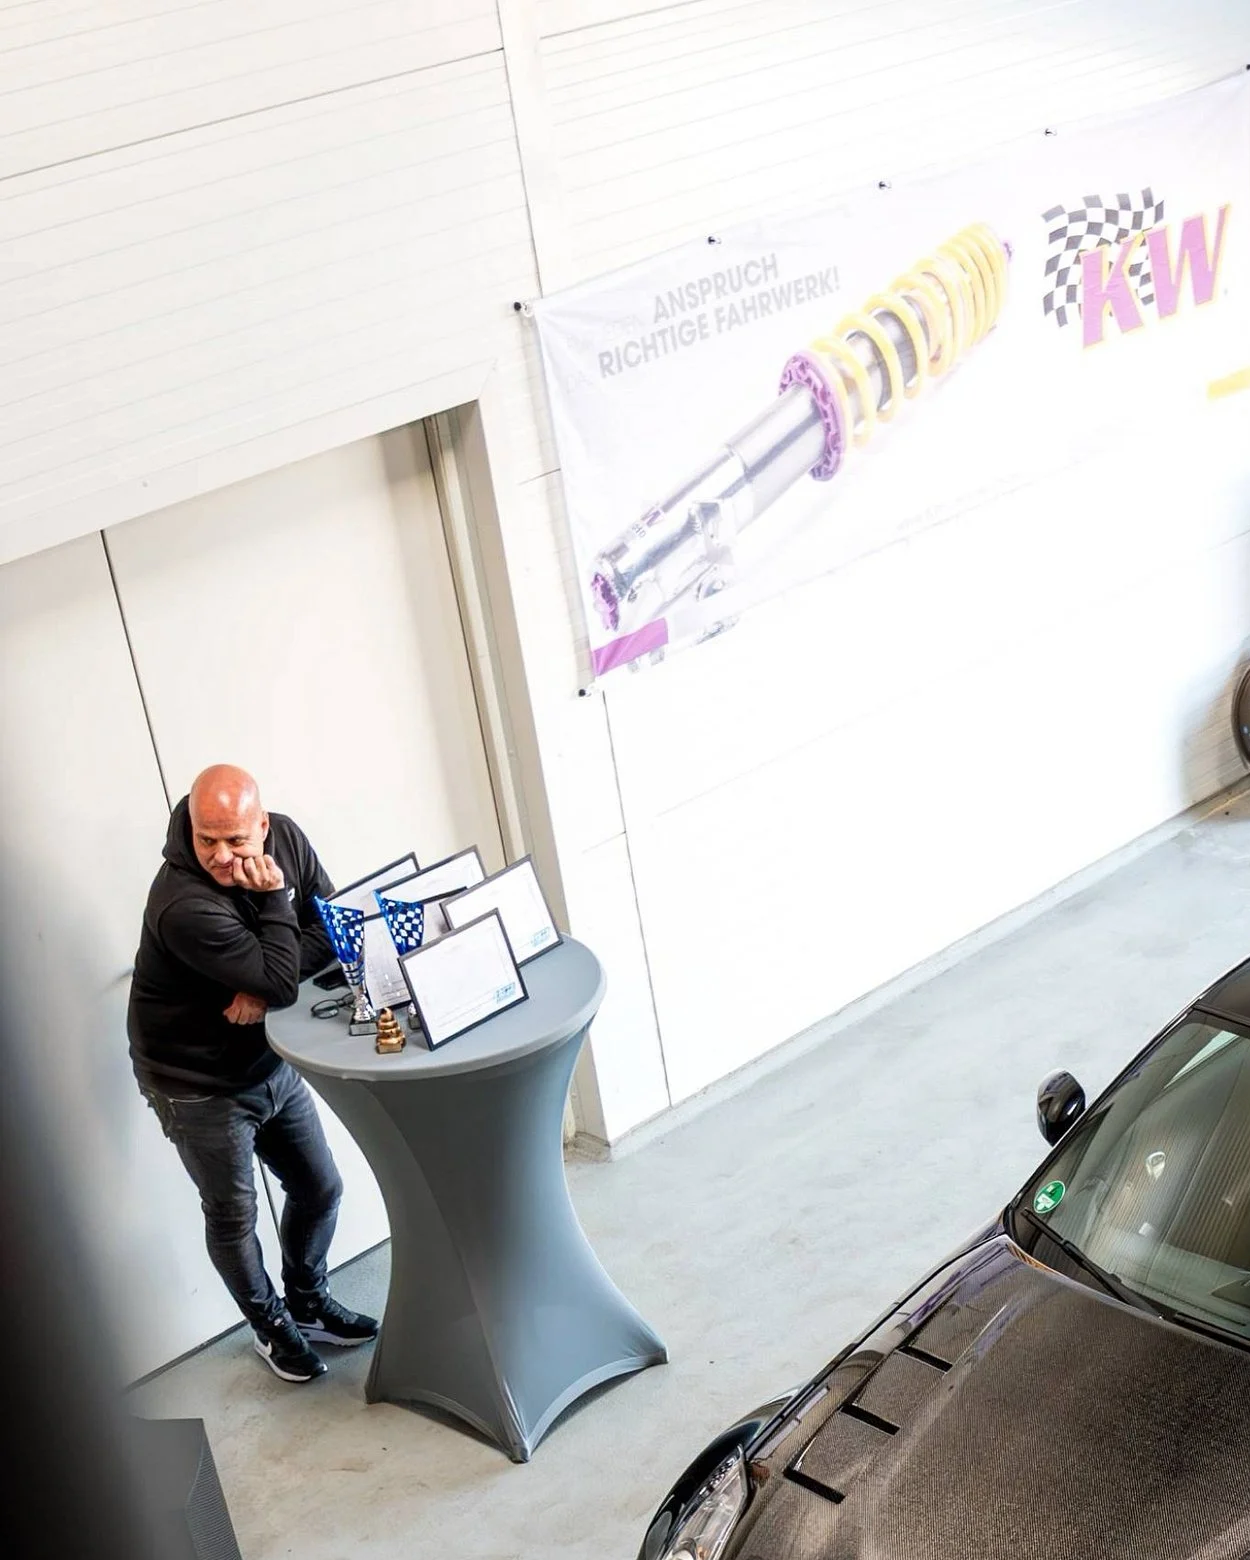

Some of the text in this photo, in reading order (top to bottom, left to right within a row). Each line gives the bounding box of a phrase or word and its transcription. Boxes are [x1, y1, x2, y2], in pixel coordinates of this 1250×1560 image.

[598, 265, 841, 379] RICHTIGE FAHRWERK!
[653, 252, 779, 324] ANSPRUCH
[1080, 203, 1232, 349] KW
